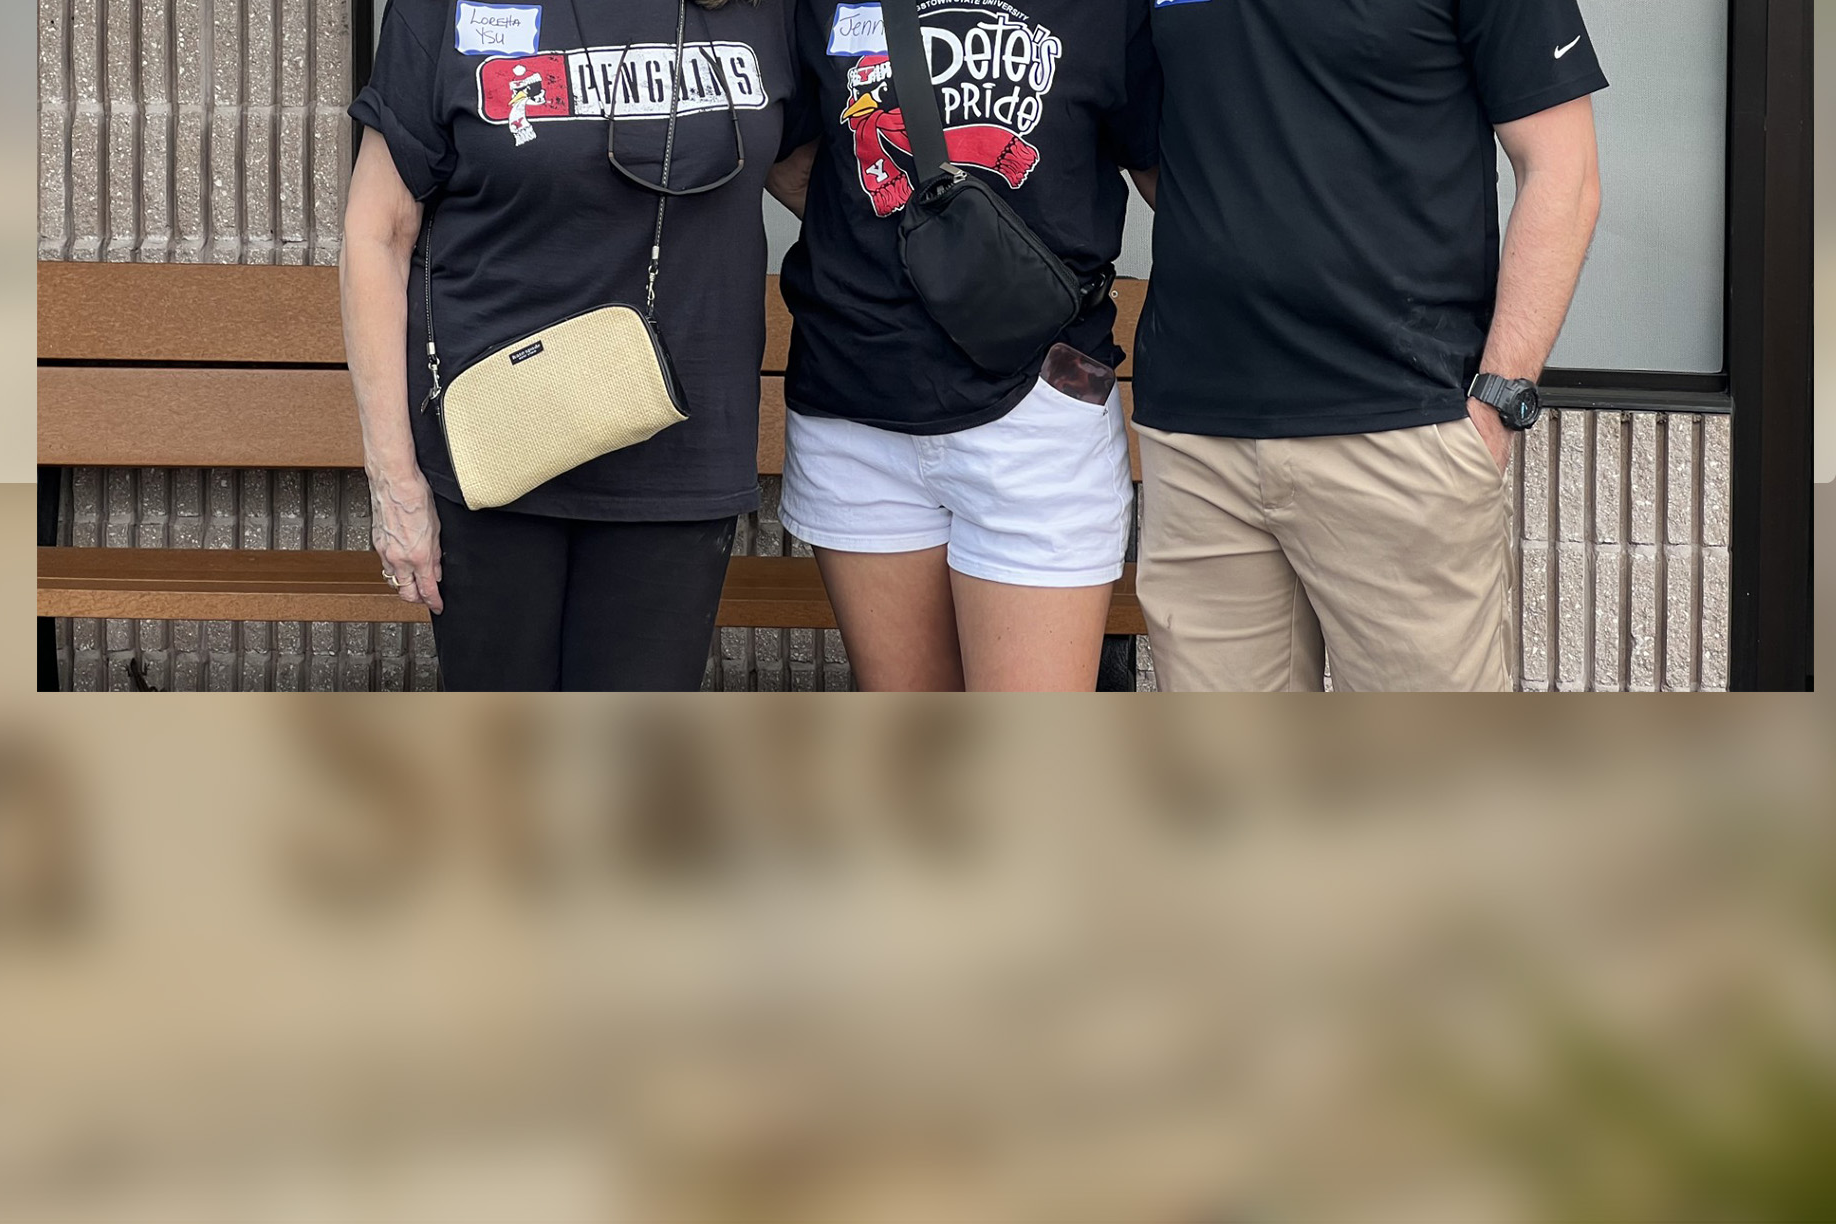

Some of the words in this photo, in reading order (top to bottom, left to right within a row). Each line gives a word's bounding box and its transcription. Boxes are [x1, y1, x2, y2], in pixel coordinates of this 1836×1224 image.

[983, 0, 1030, 21] UNIVERSITY
[475, 27, 505, 45] YSU
[866, 158, 888, 183] Y
